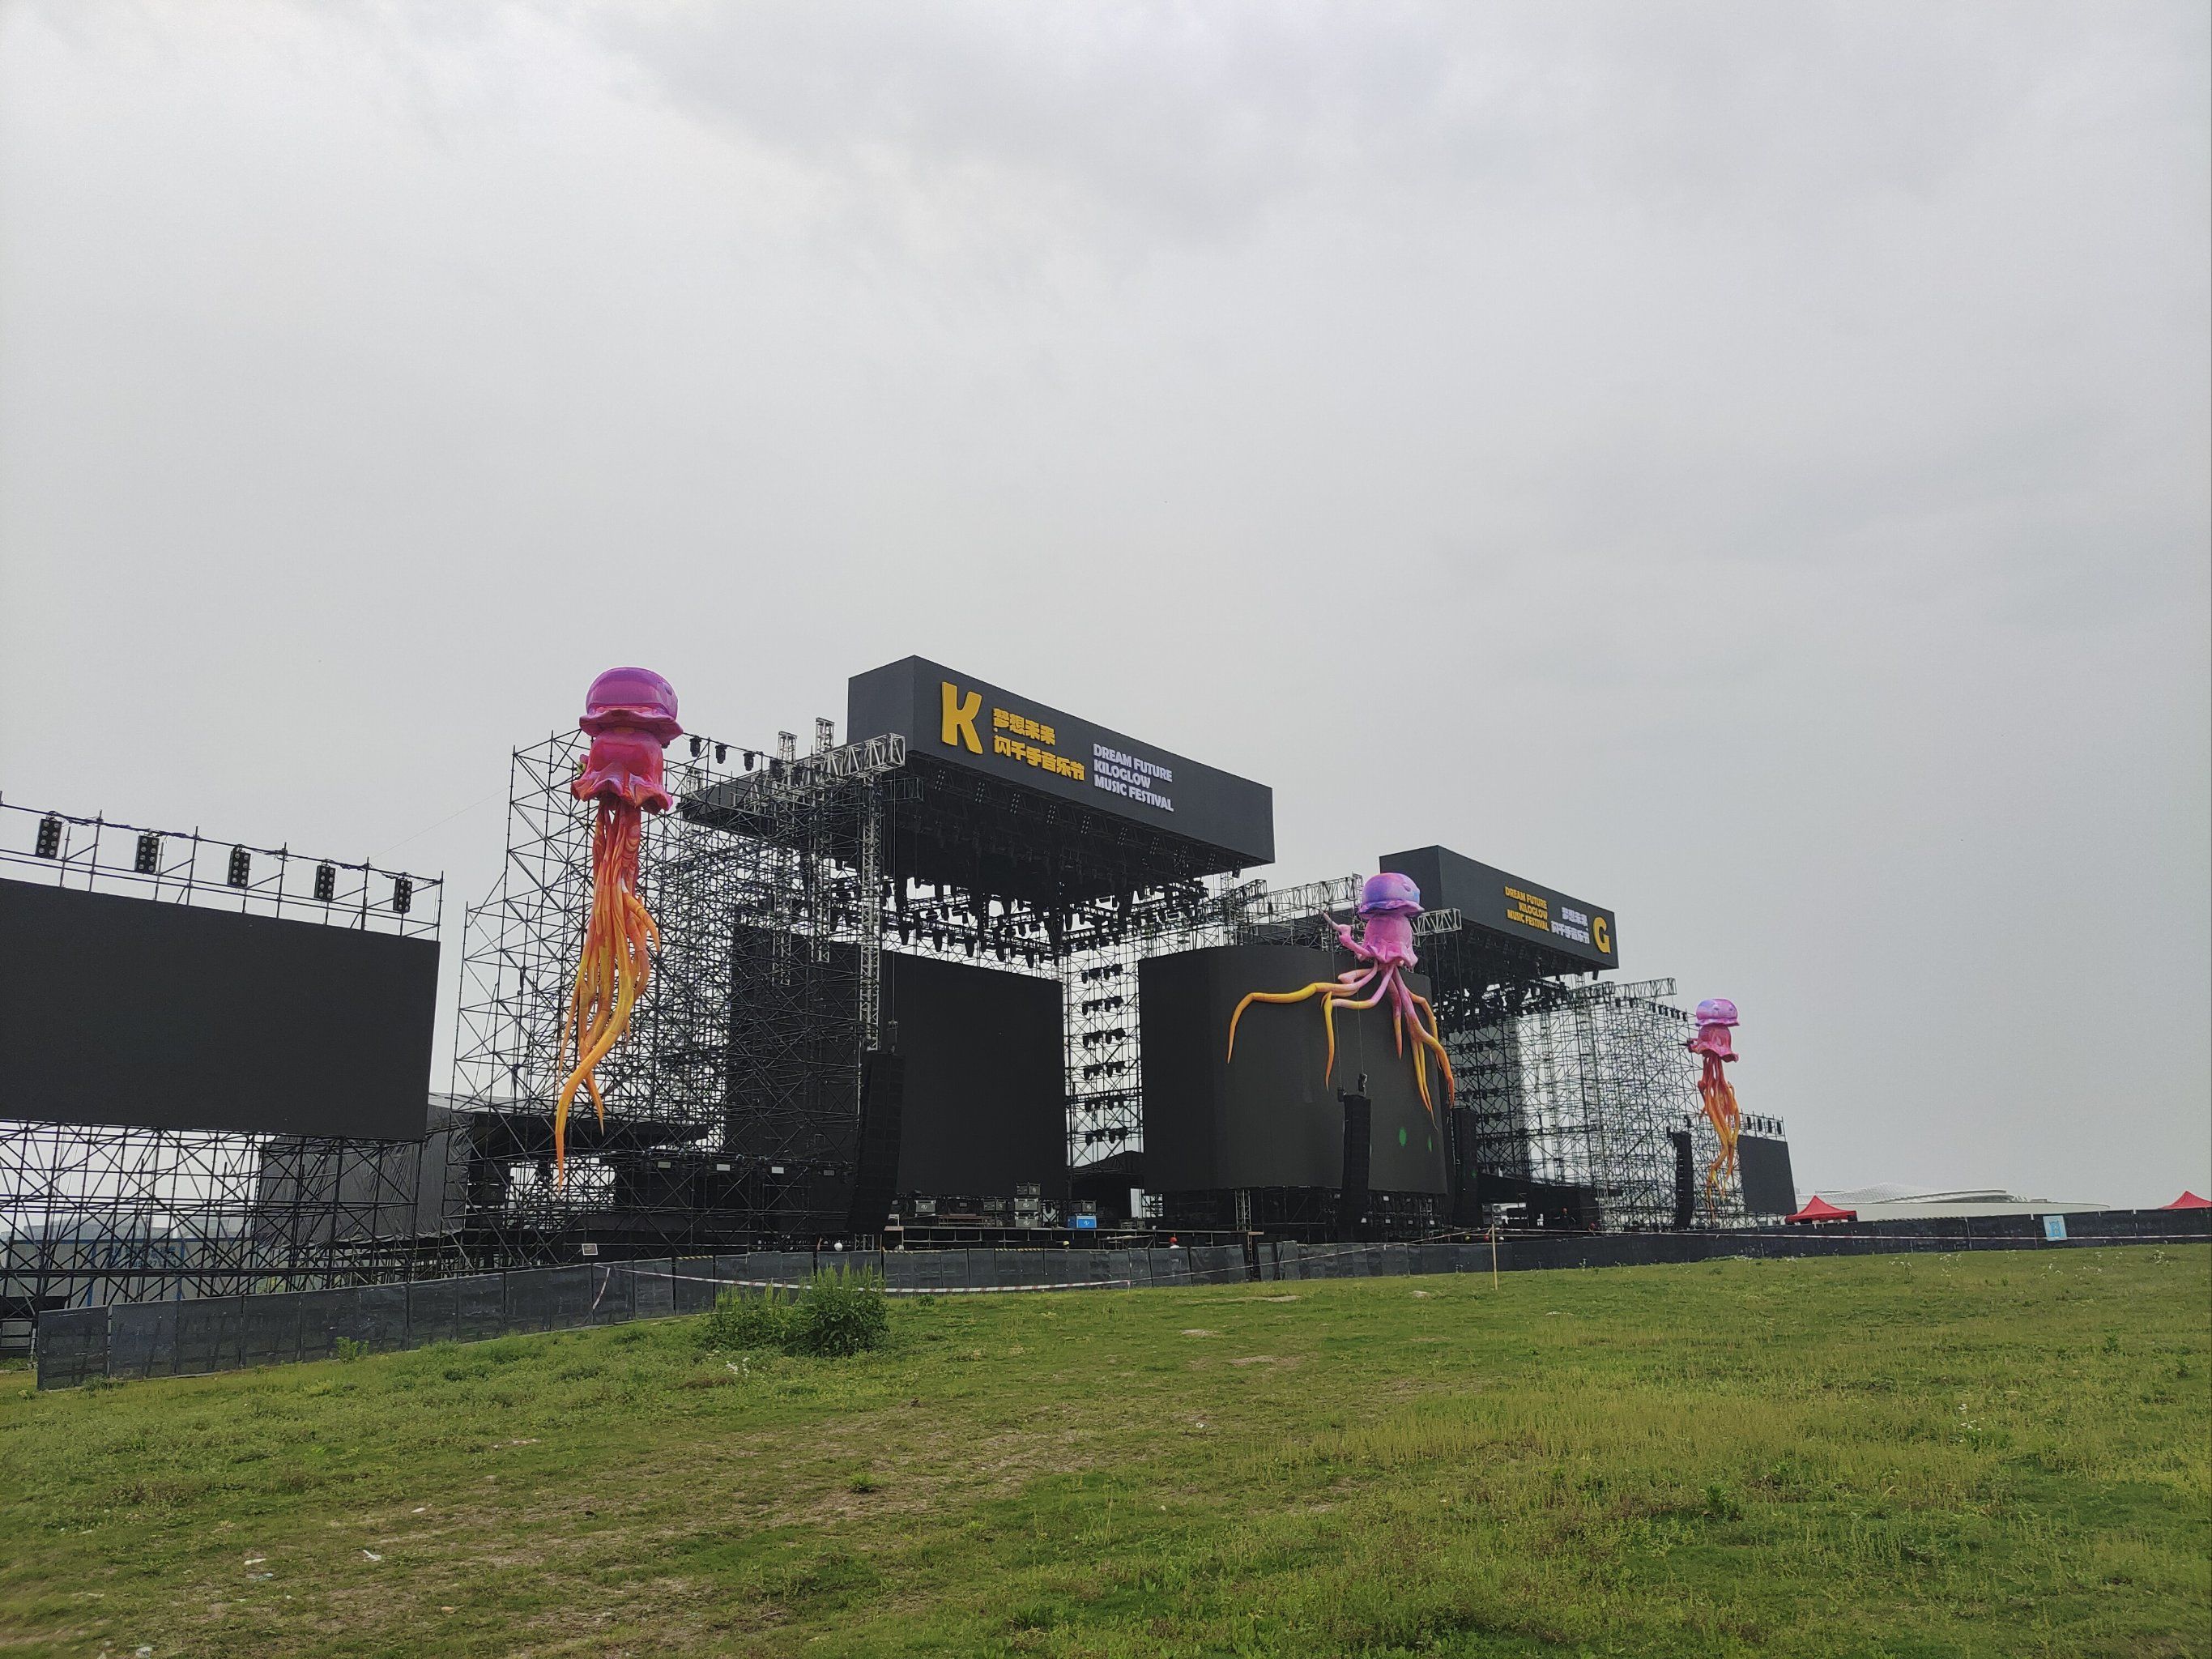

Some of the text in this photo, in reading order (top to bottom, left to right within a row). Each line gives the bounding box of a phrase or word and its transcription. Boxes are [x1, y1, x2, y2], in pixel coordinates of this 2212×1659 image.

[942, 681, 982, 754] K
[994, 735, 1085, 781] 闪千手音乐节
[1093, 744, 1172, 782] DREAM FUTURE
[1093, 759, 1150, 788] KILOGLOW
[1094, 774, 1174, 812] MUSIC FESTIVAL
[1505, 886, 1547, 909] DREAM FUTURE
[1519, 902, 1548, 919] KILOGLOW
[1507, 909, 1549, 931] MUSIC FESTIVAL
[1593, 917, 1610, 953] G
